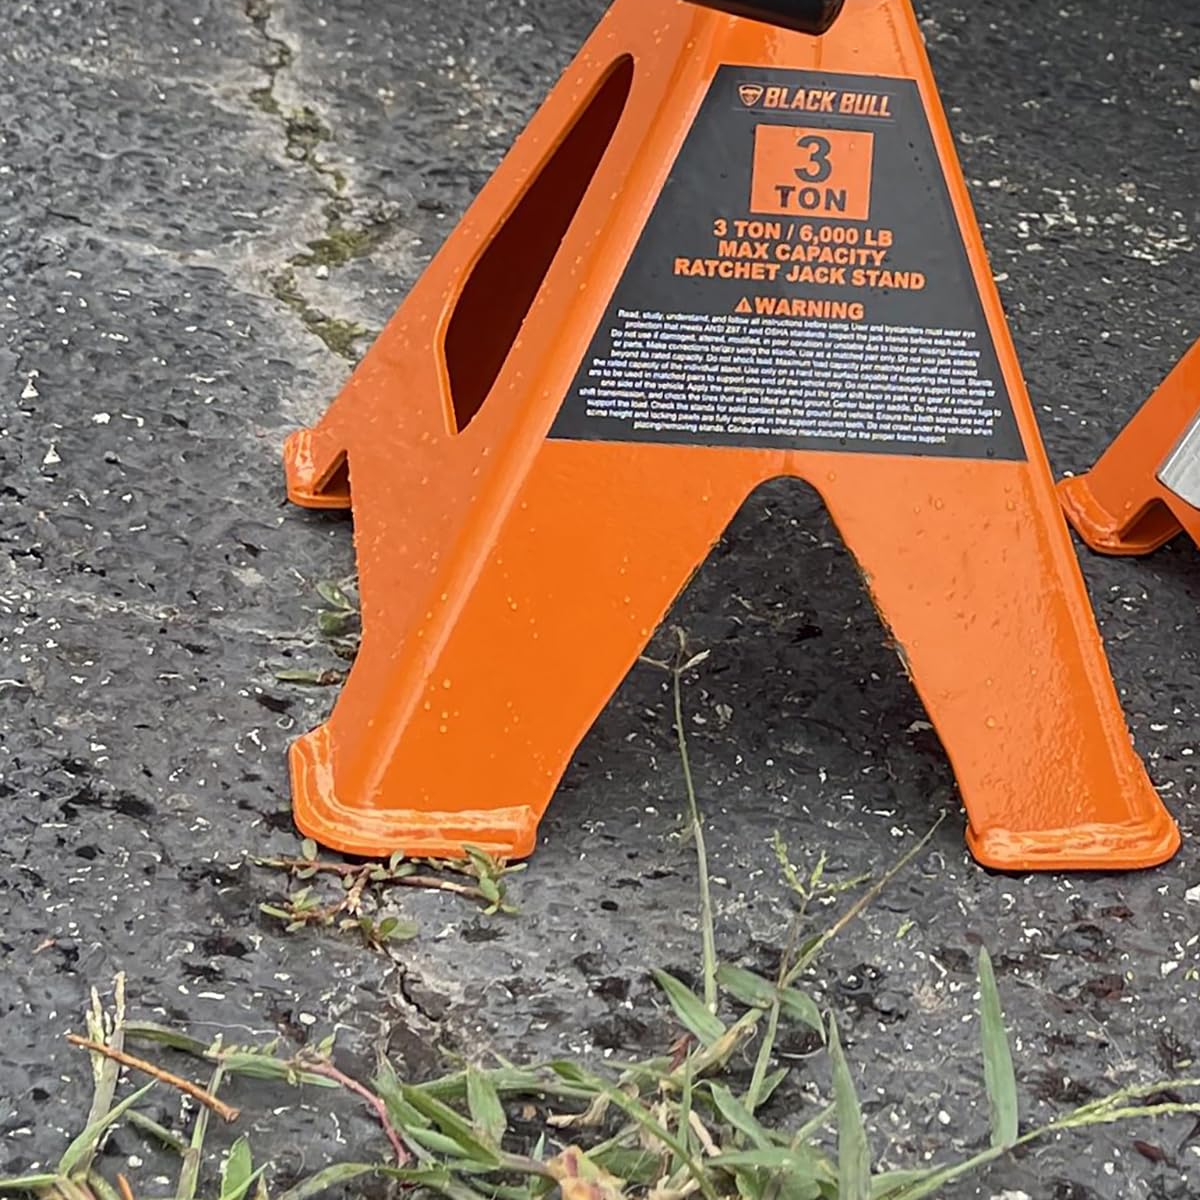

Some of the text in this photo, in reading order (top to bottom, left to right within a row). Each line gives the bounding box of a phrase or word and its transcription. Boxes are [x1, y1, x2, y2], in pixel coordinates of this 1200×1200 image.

[764, 87, 892, 117] BLACK BULL
[794, 136, 832, 182] 3
[775, 186, 846, 212] TON
[713, 220, 892, 248] 3 TON / 6,000 LB
[718, 240, 886, 266] MAX CAPACITY
[674, 258, 926, 290] RATCHET JACK STAND
[755, 298, 864, 320] WARNING
